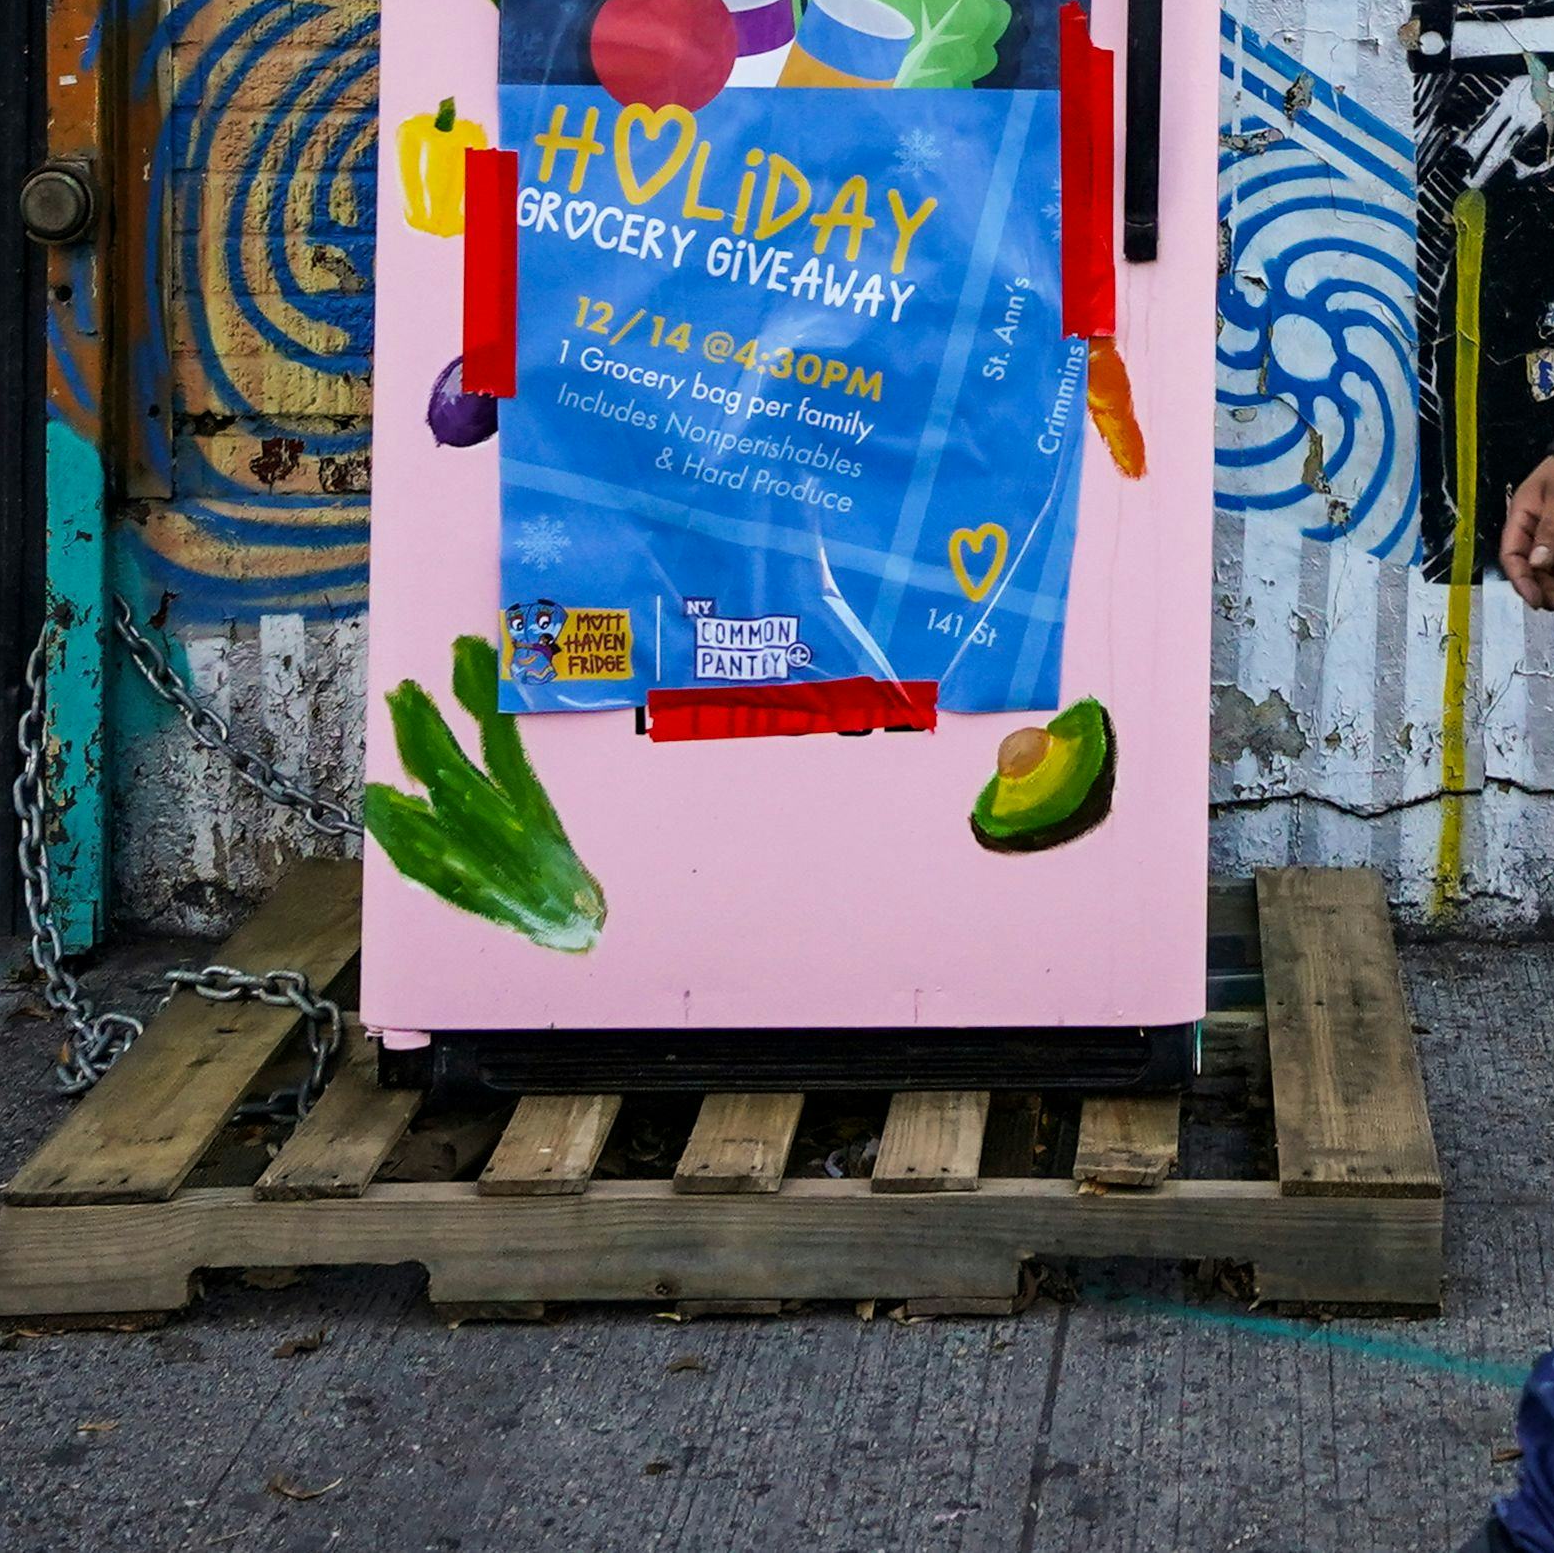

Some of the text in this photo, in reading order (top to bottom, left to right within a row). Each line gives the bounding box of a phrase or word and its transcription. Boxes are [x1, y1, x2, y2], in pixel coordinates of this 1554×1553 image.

[559, 339, 874, 445] 1 Grocery bag per family
[1037, 345, 1085, 455] Crimmins
[556, 382, 863, 479] Includes Nonperishables
[655, 446, 853, 513] & Hard Produce
[576, 613, 626, 632] MOTT
[686, 600, 713, 615] NY
[927, 607, 997, 648] 141 St
[563, 631, 626, 654] HAVEN
[701, 620, 791, 646] COMMON
